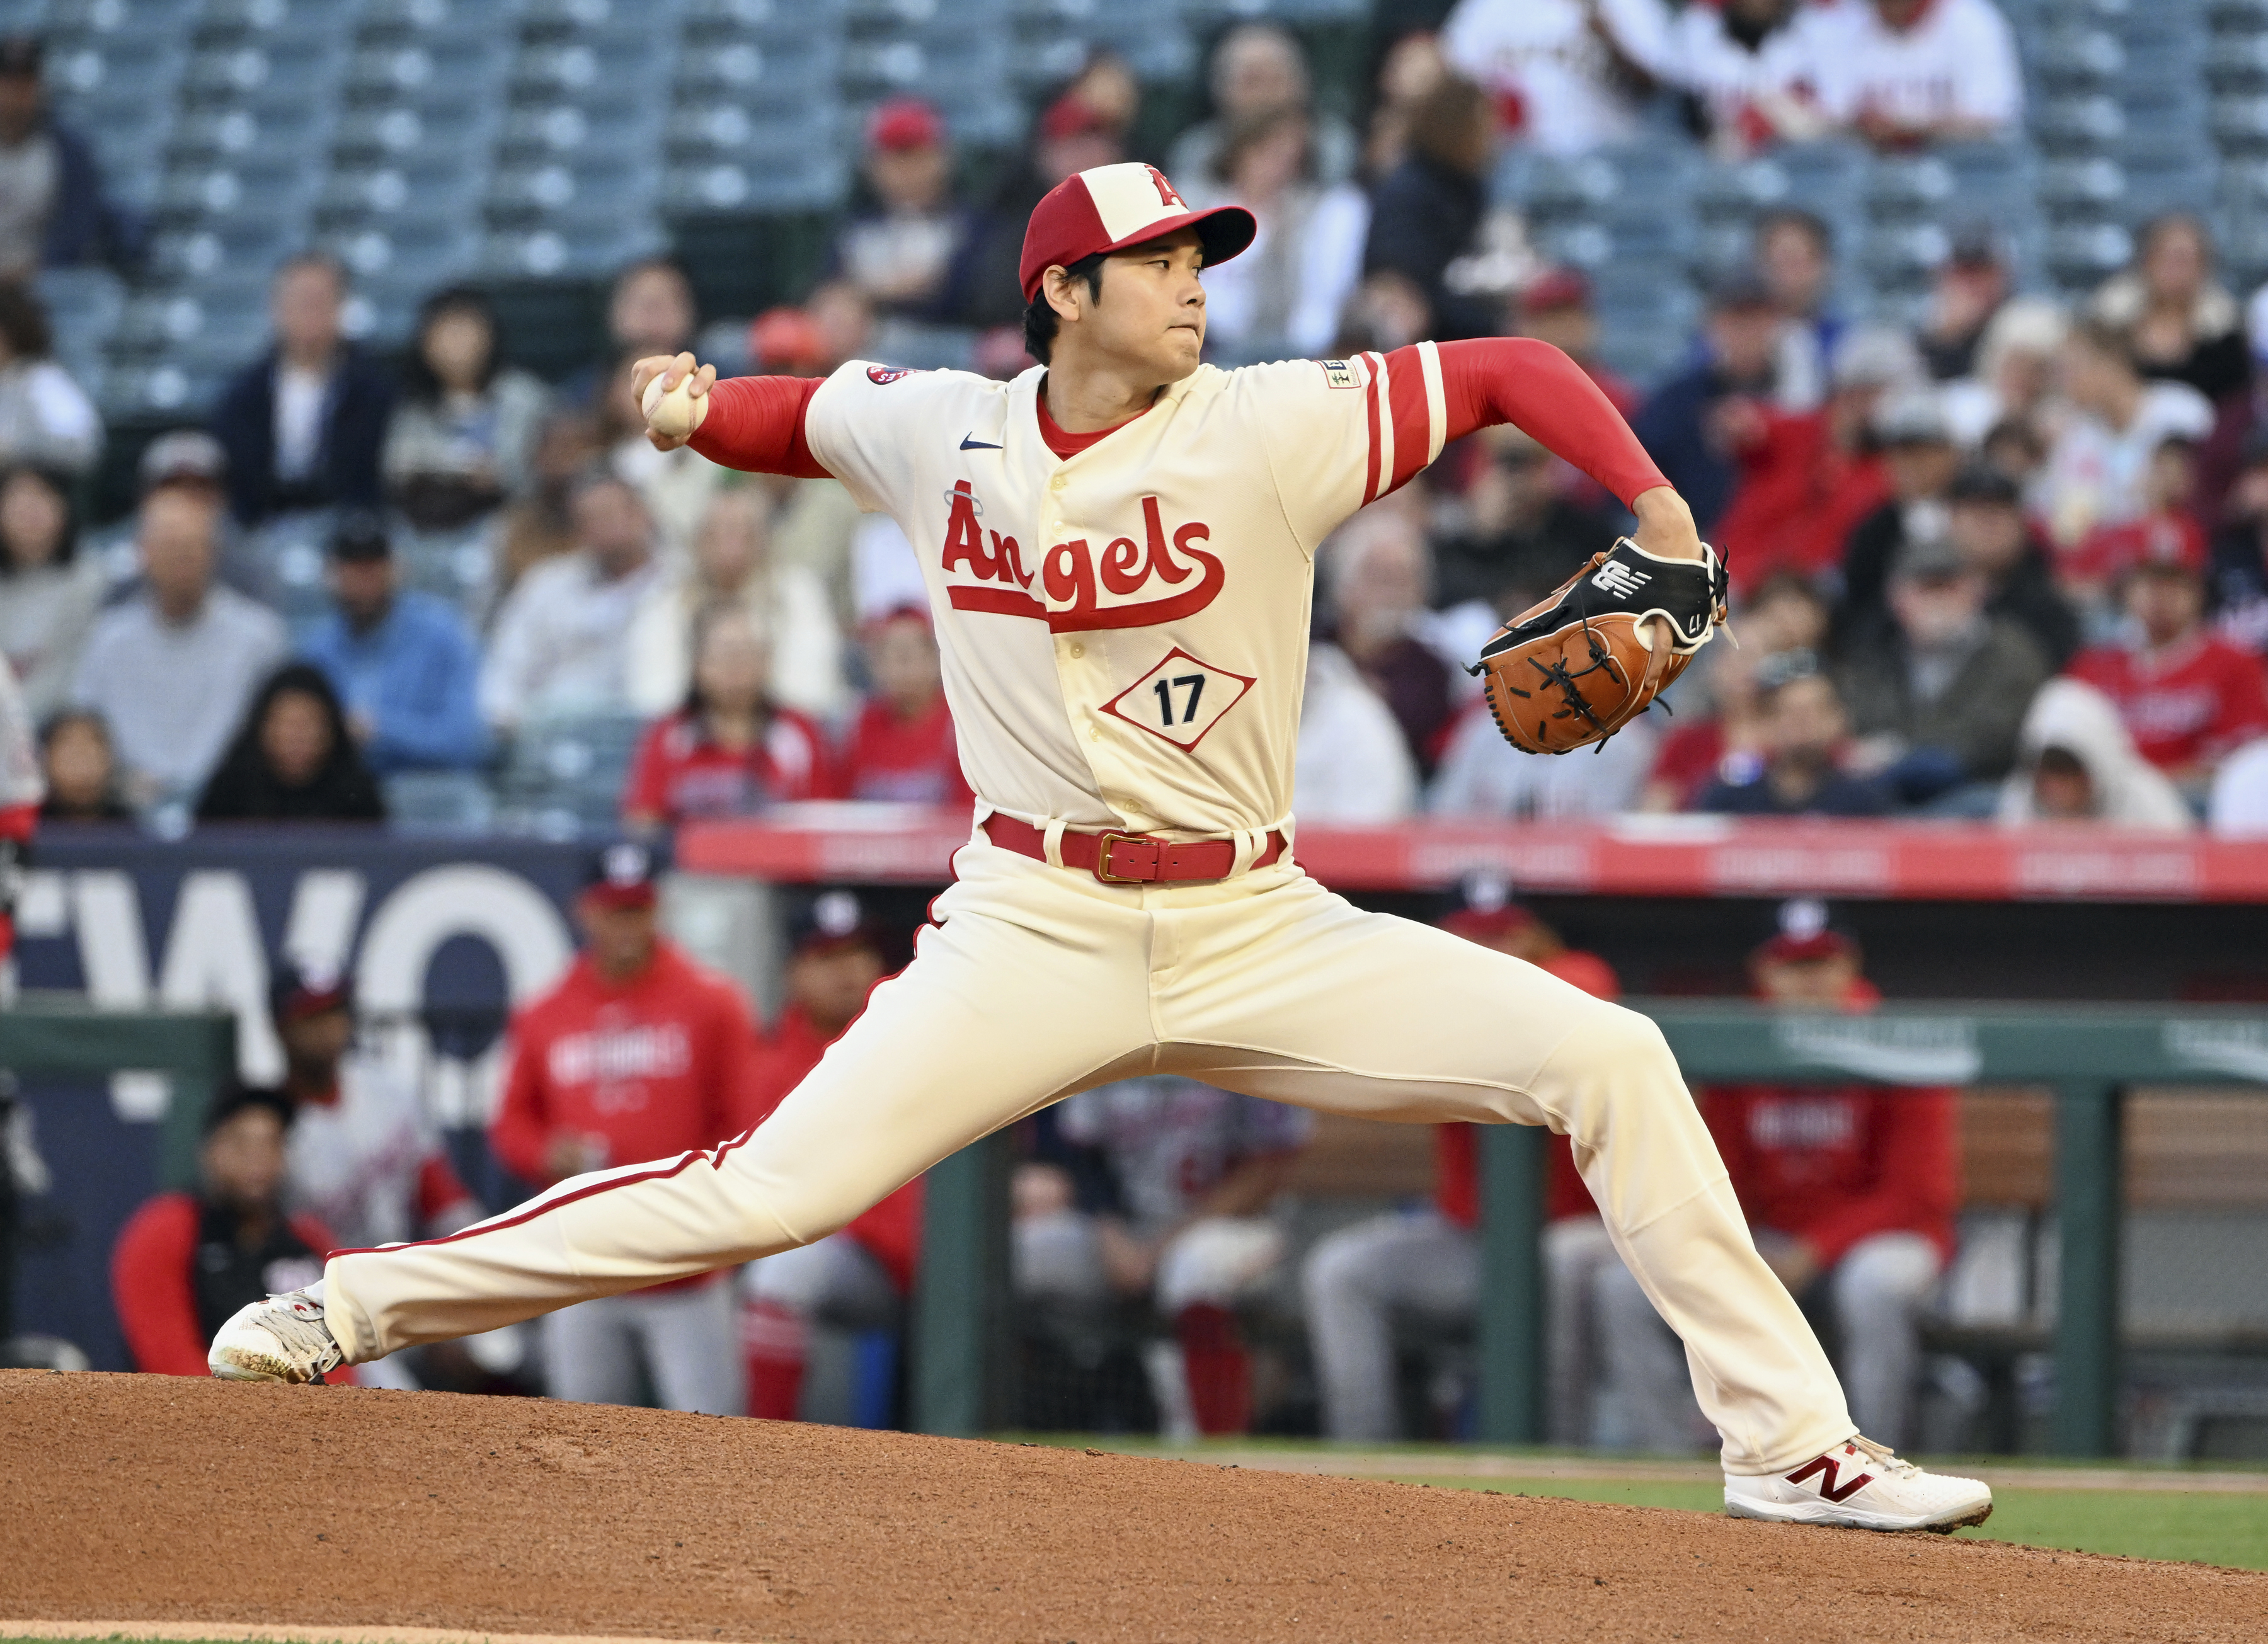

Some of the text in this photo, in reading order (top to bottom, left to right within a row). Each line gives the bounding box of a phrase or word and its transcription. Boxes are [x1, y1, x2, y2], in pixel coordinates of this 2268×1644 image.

[1143, 164, 1188, 207] A
[942, 479, 1225, 634] Angels
[1153, 673, 1206, 728] 17
